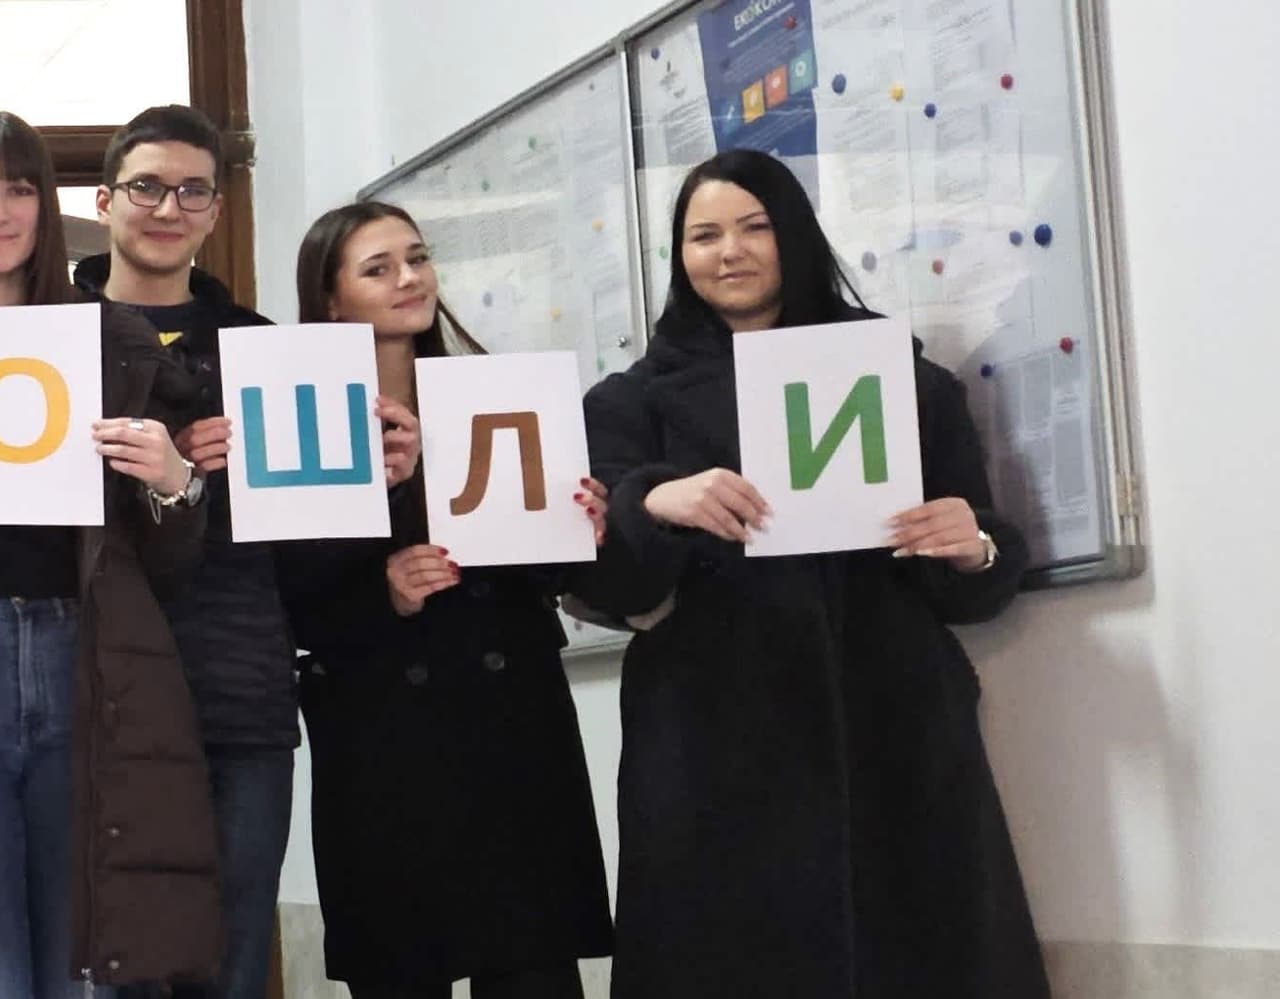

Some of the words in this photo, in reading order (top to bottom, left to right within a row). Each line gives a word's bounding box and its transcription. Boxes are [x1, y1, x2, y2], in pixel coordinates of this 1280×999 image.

[240, 383, 372, 488] Ш
[450, 411, 547, 516] Л
[787, 379, 888, 490] И
